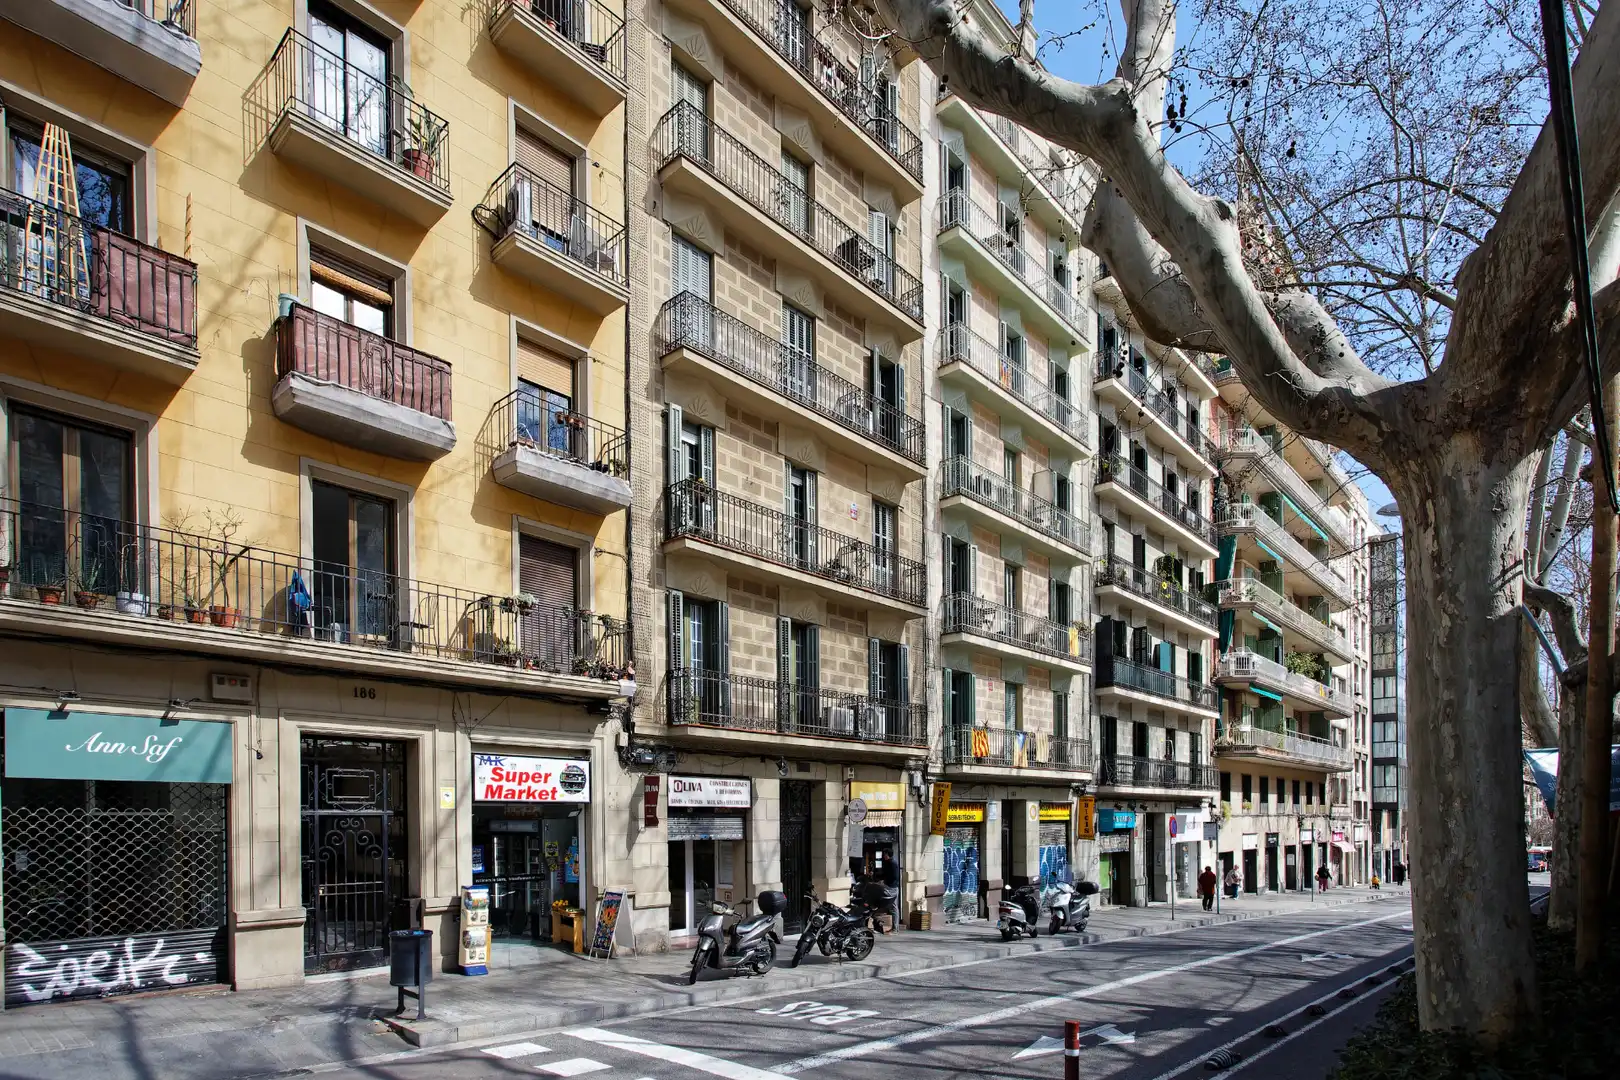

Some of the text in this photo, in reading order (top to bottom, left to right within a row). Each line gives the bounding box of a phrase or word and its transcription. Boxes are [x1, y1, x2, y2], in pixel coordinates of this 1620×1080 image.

[353, 686, 376, 700] 186
[66, 731, 130, 753] Ann
[490, 766, 552, 786] Super
[673, 779, 702, 793] OLIVA
[484, 784, 558, 801] Market
[935, 790, 945, 826] MOTOS
[754, 1001, 881, 1025] BUS
